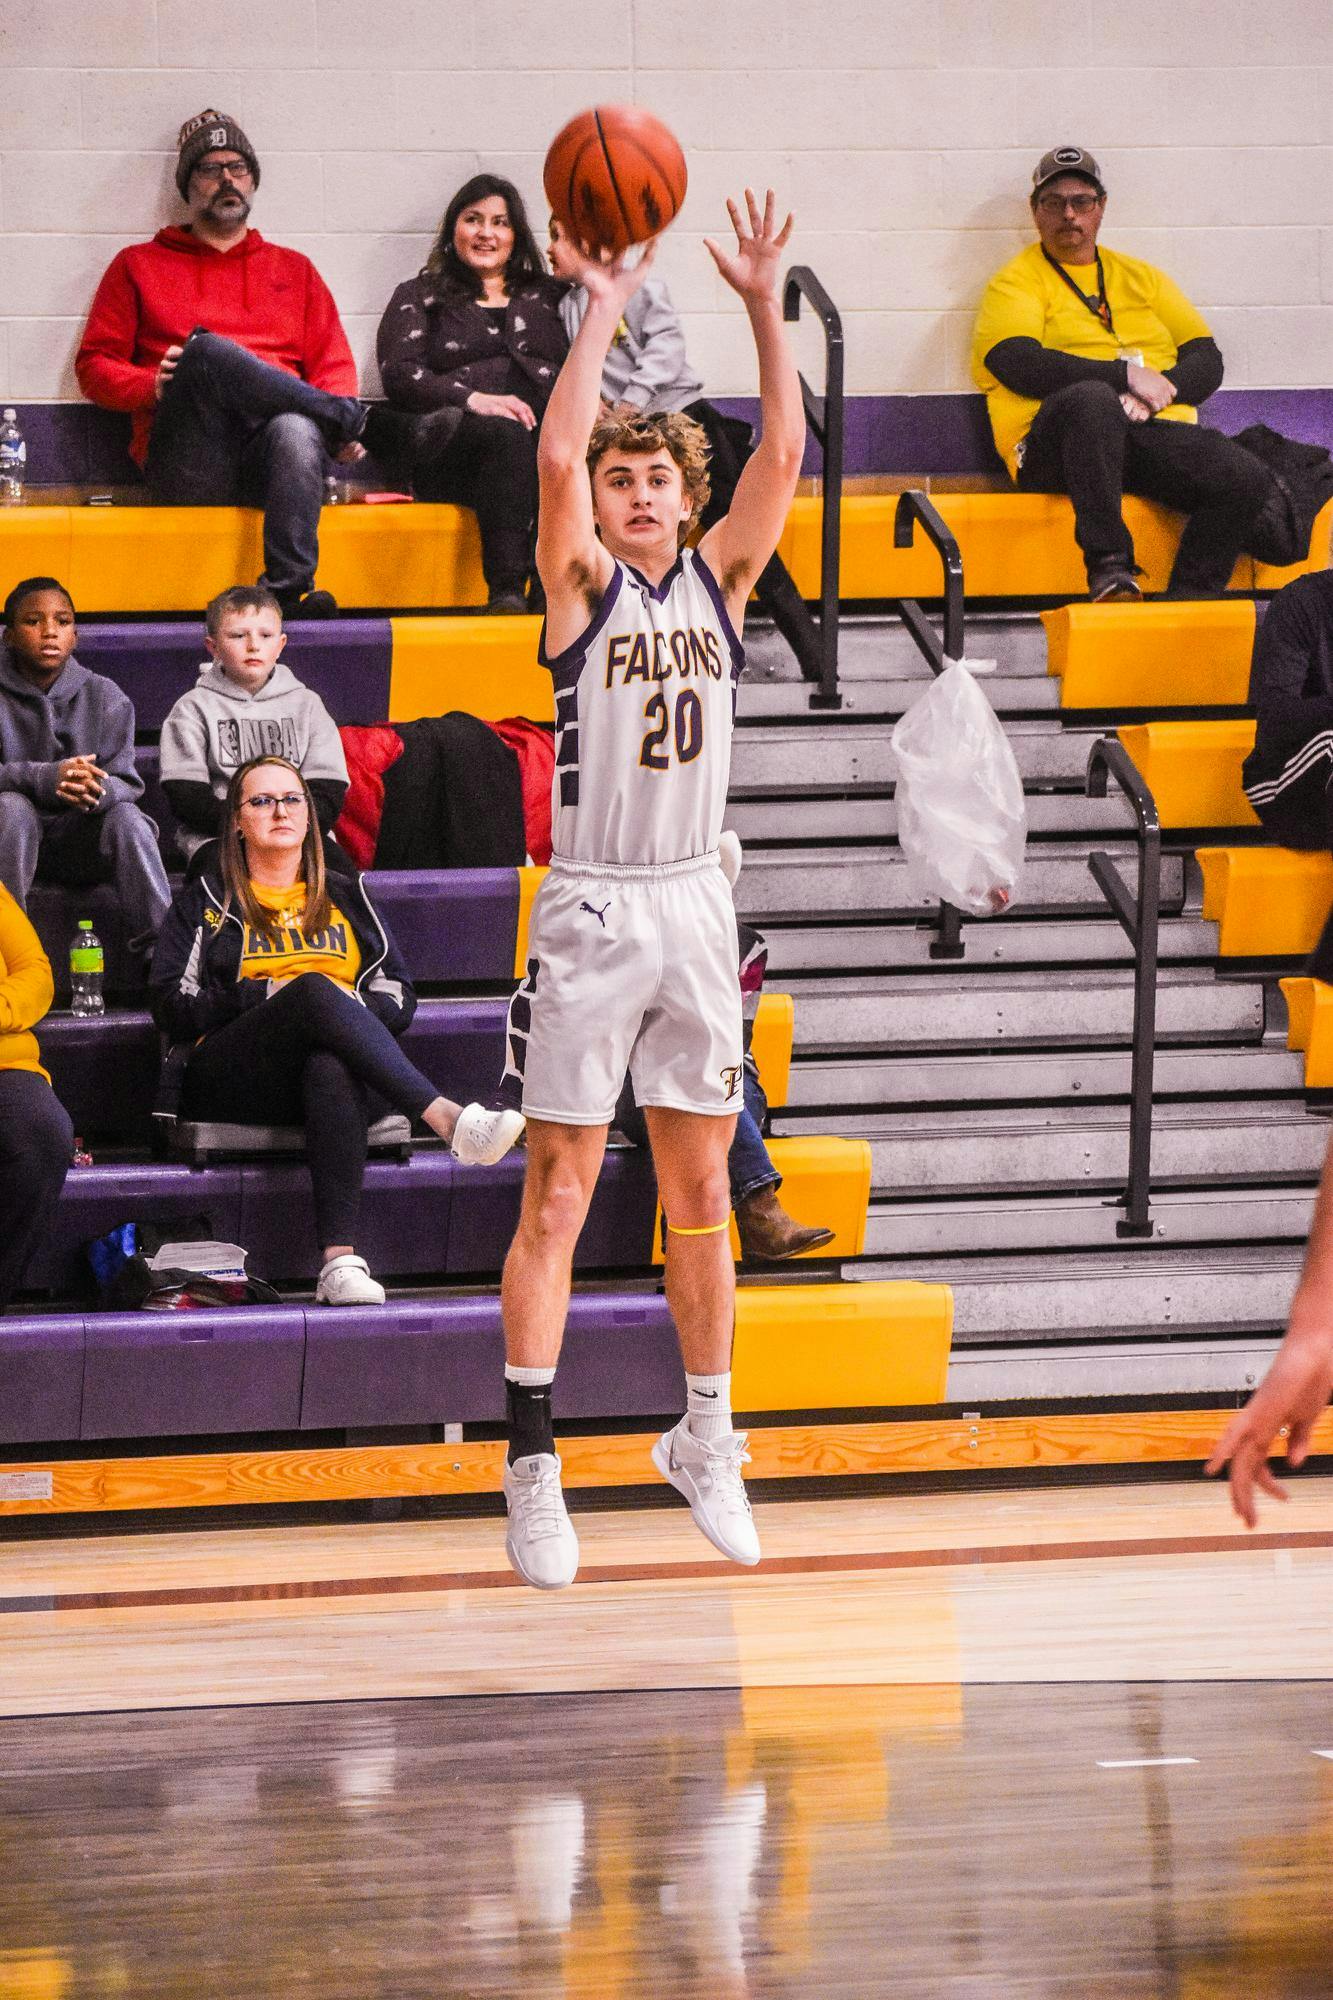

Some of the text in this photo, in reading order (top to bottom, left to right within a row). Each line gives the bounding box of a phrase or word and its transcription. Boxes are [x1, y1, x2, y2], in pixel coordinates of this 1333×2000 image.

[210, 128, 227, 147] D
[605, 627, 722, 689] FALCONS
[240, 718, 300, 764] NBA
[639, 688, 703, 771] 20
[244, 923, 347, 954] ATION
